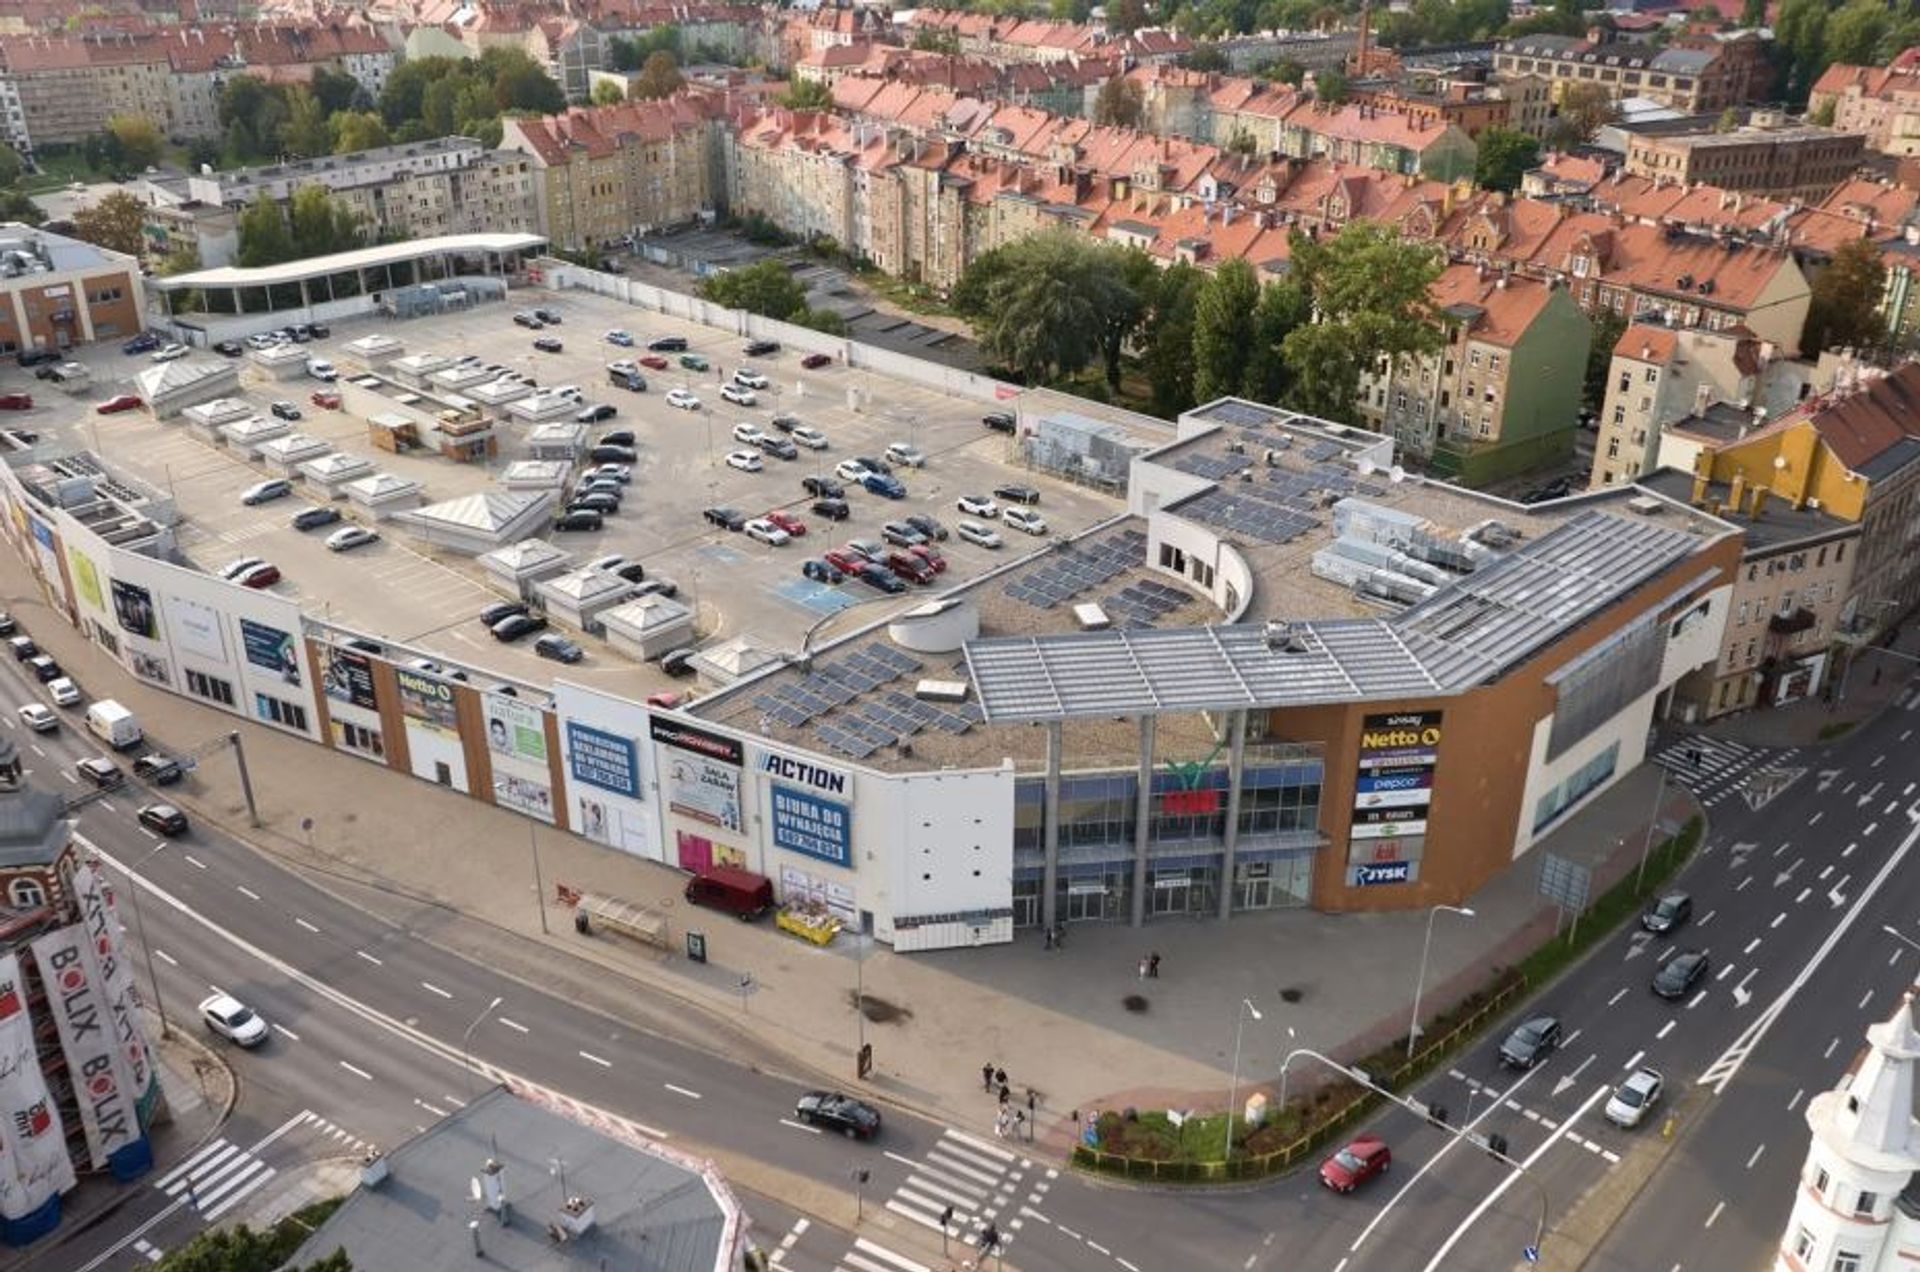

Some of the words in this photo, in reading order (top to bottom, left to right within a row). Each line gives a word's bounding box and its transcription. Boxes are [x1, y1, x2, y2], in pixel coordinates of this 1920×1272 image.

[398, 672, 436, 696] Netto
[1361, 729, 1419, 748] Netto
[766, 754, 846, 794] ACTION
[1373, 777, 1417, 790] pepco
[1367, 867, 1407, 880] JYSK
[50, 944, 102, 1043] BOLIX
[81, 1052, 129, 1147] BOLIX
